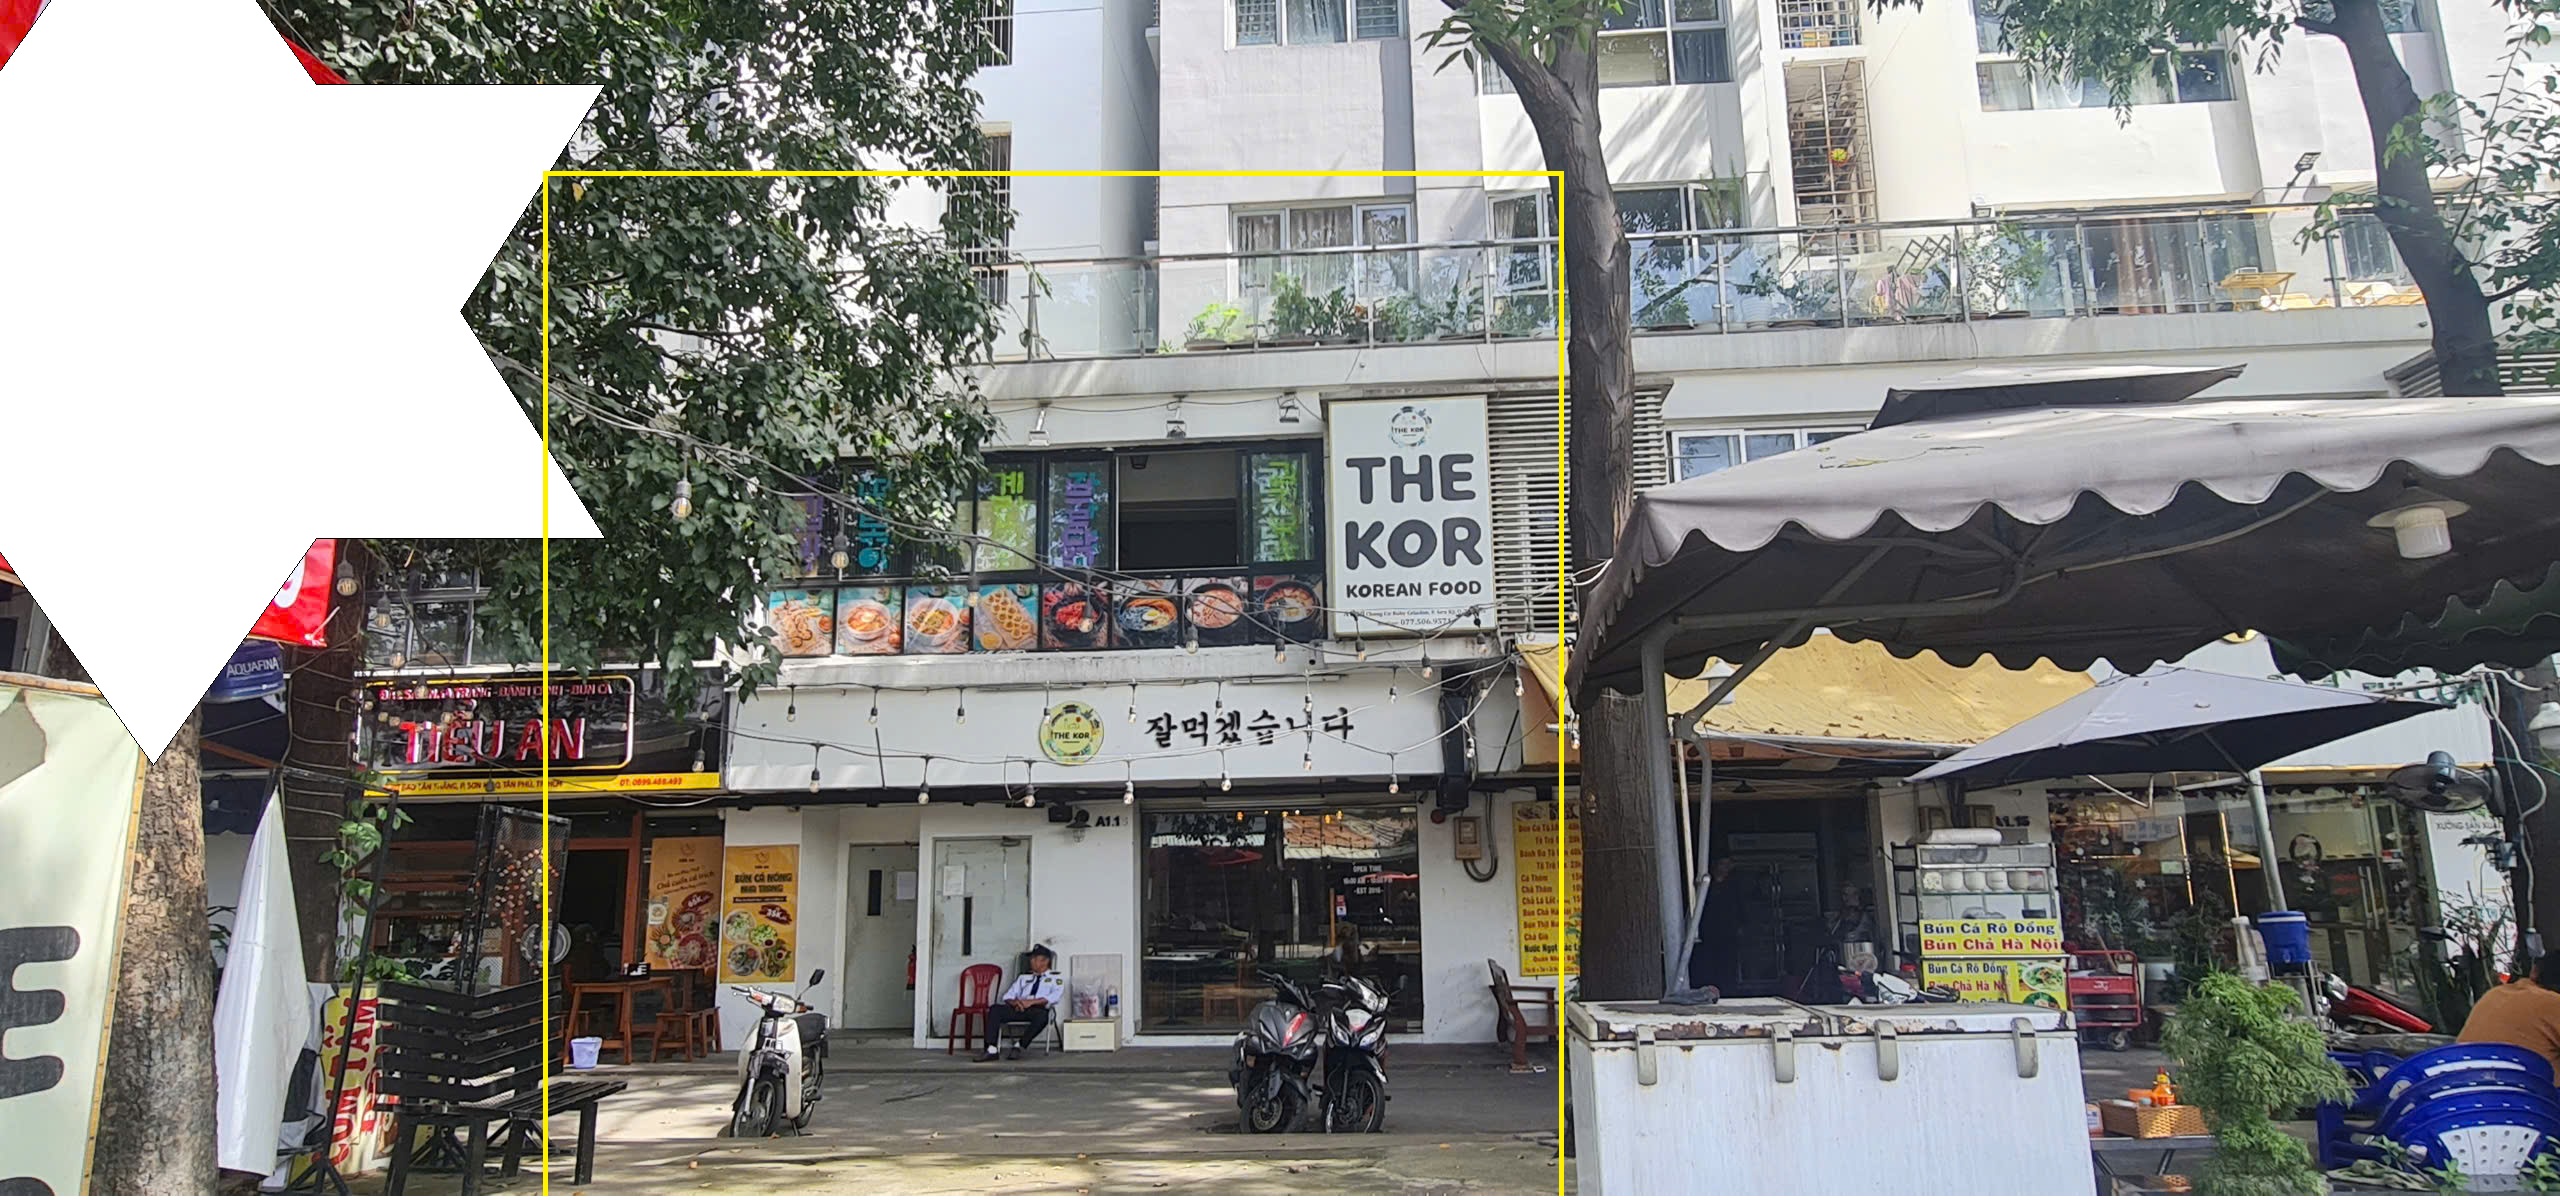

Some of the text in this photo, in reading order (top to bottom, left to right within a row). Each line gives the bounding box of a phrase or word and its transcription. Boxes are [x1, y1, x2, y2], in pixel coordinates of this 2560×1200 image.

[1345, 453, 1476, 505] THE
[1345, 517, 1483, 571] KOR
[1346, 580, 1482, 599] KOREAN FOOD
[226, 656, 280, 679] AQUAFINA
[400, 699, 586, 765] TIỂU AN
[1144, 706, 1355, 749] 잘먹겠습니다
[1924, 923, 1955, 934] Bún
[1960, 922, 1980, 934] Cá
[1987, 922, 2008, 934] Rô
[1923, 938, 2059, 952] Bún Chả Hà Nội
[1928, 963, 1948, 974] Bún
[1950, 962, 1963, 974] Cá
[1952, 980, 1972, 991] Chả
[1976, 980, 1990, 991] Hà
